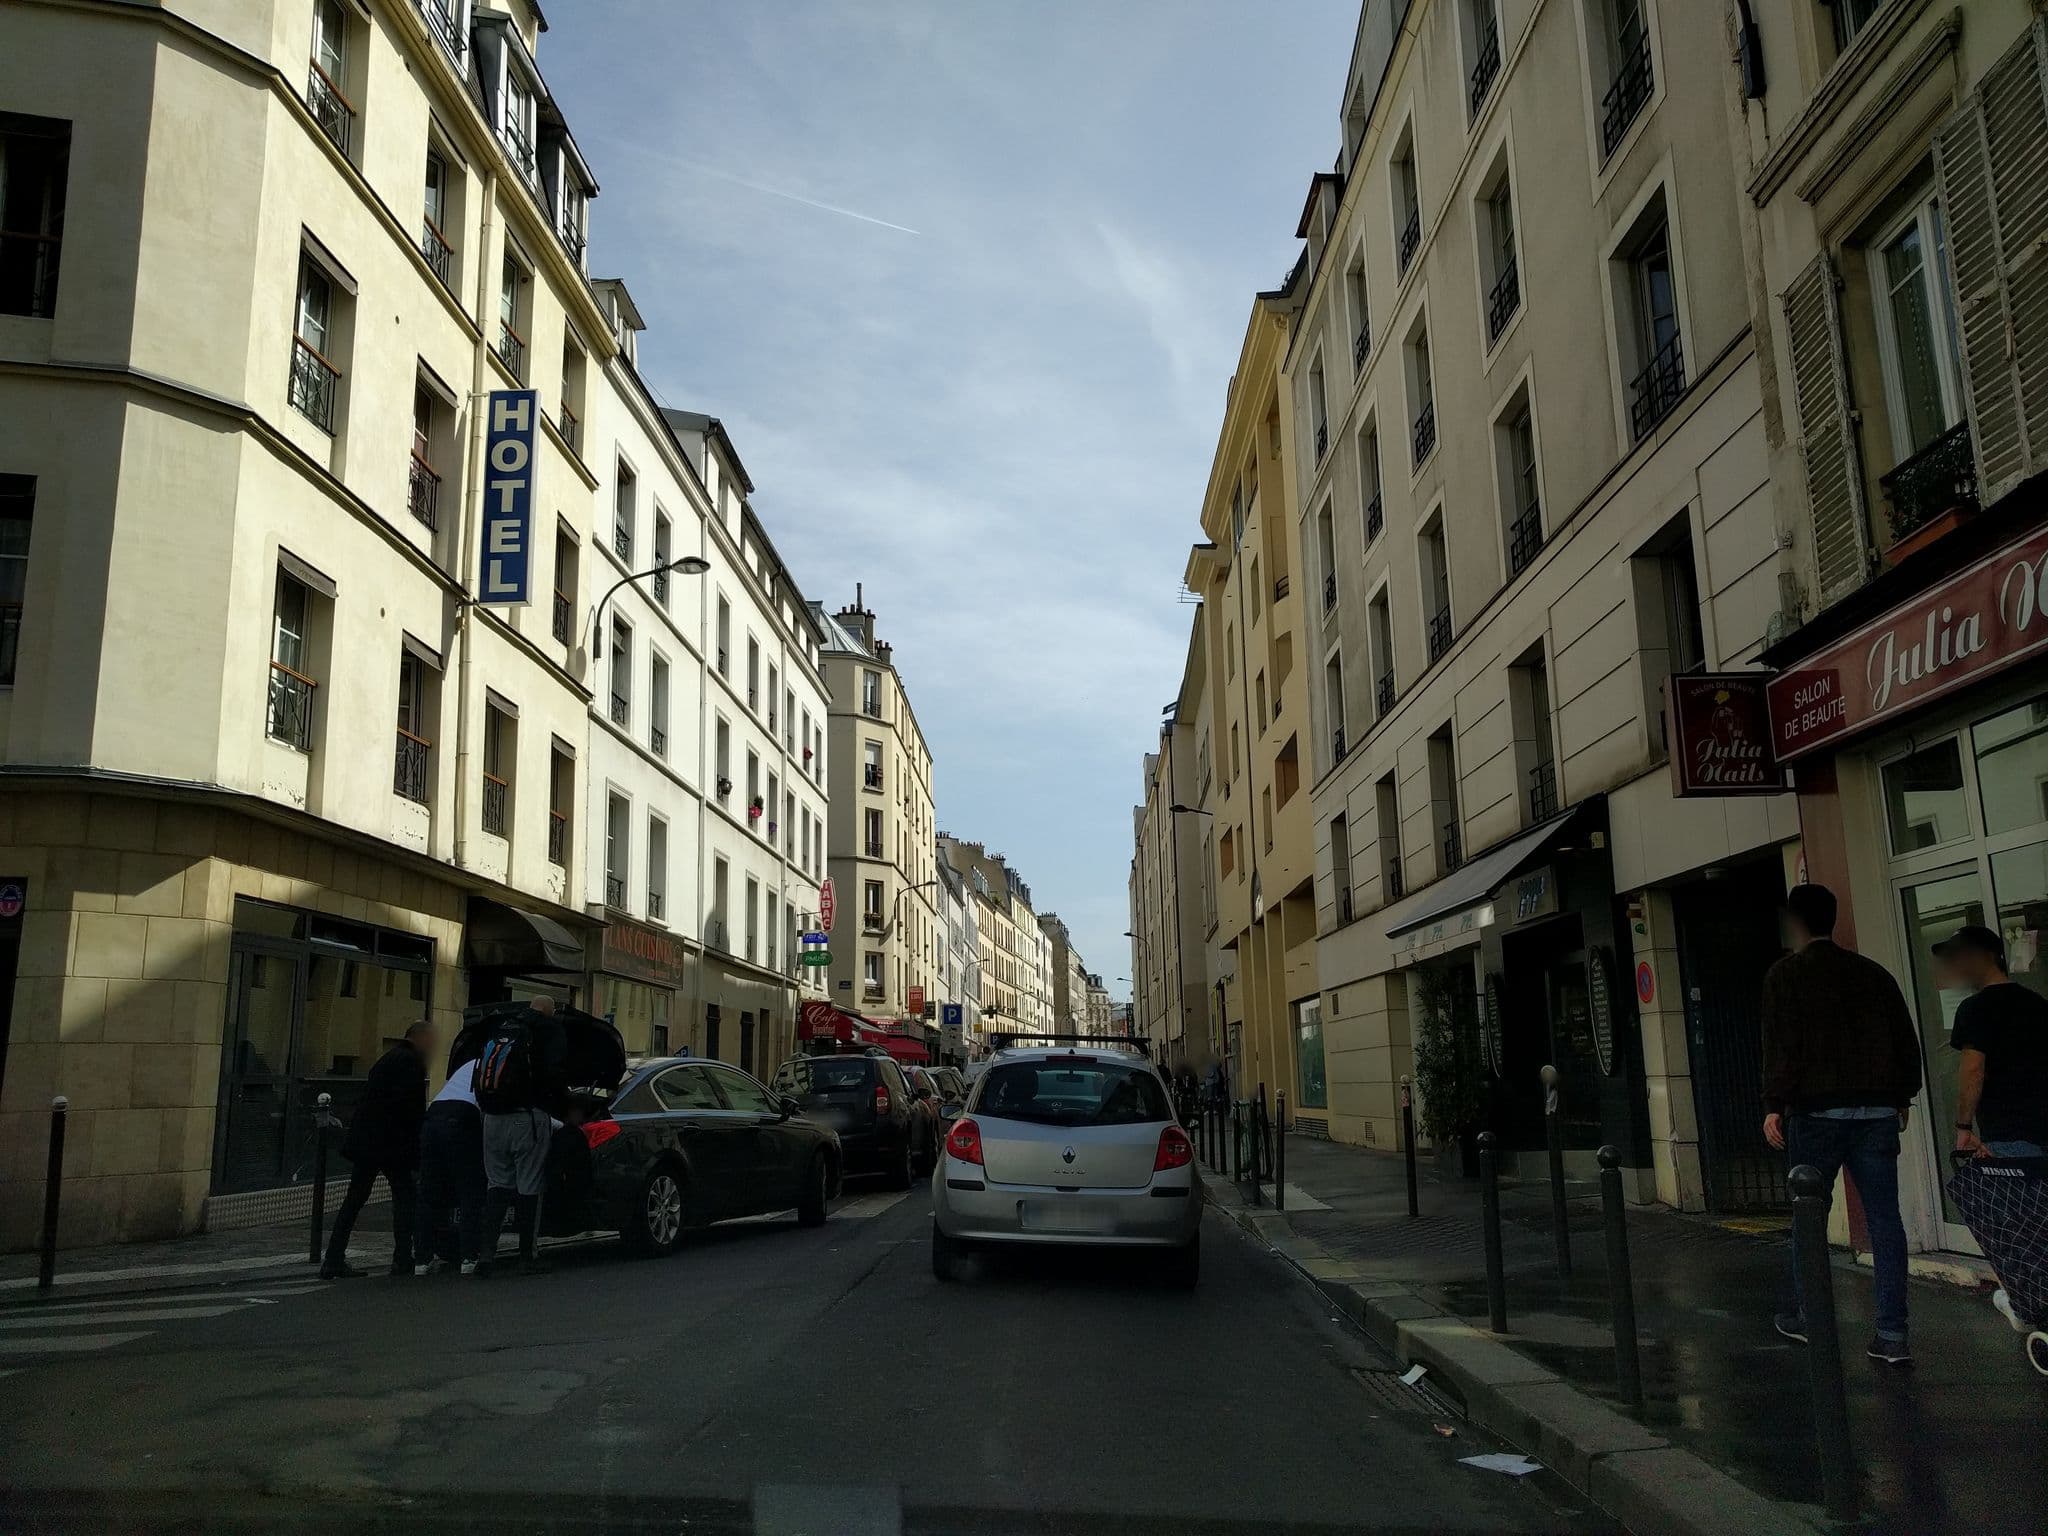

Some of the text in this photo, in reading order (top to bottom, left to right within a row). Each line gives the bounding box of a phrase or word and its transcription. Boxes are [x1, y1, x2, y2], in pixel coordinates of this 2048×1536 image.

[488, 399, 529, 593] HOTEL
[1867, 606, 1987, 712] Julia
[1793, 675, 1831, 710] SALON
[1784, 695, 1846, 741] DE BEAUTE
[1695, 736, 1763, 764] Julia
[1696, 758, 1765, 784] Nails
[821, 880, 832, 927] TABAC
[806, 1005, 839, 1025] Café
[948, 1008, 957, 1021] P
